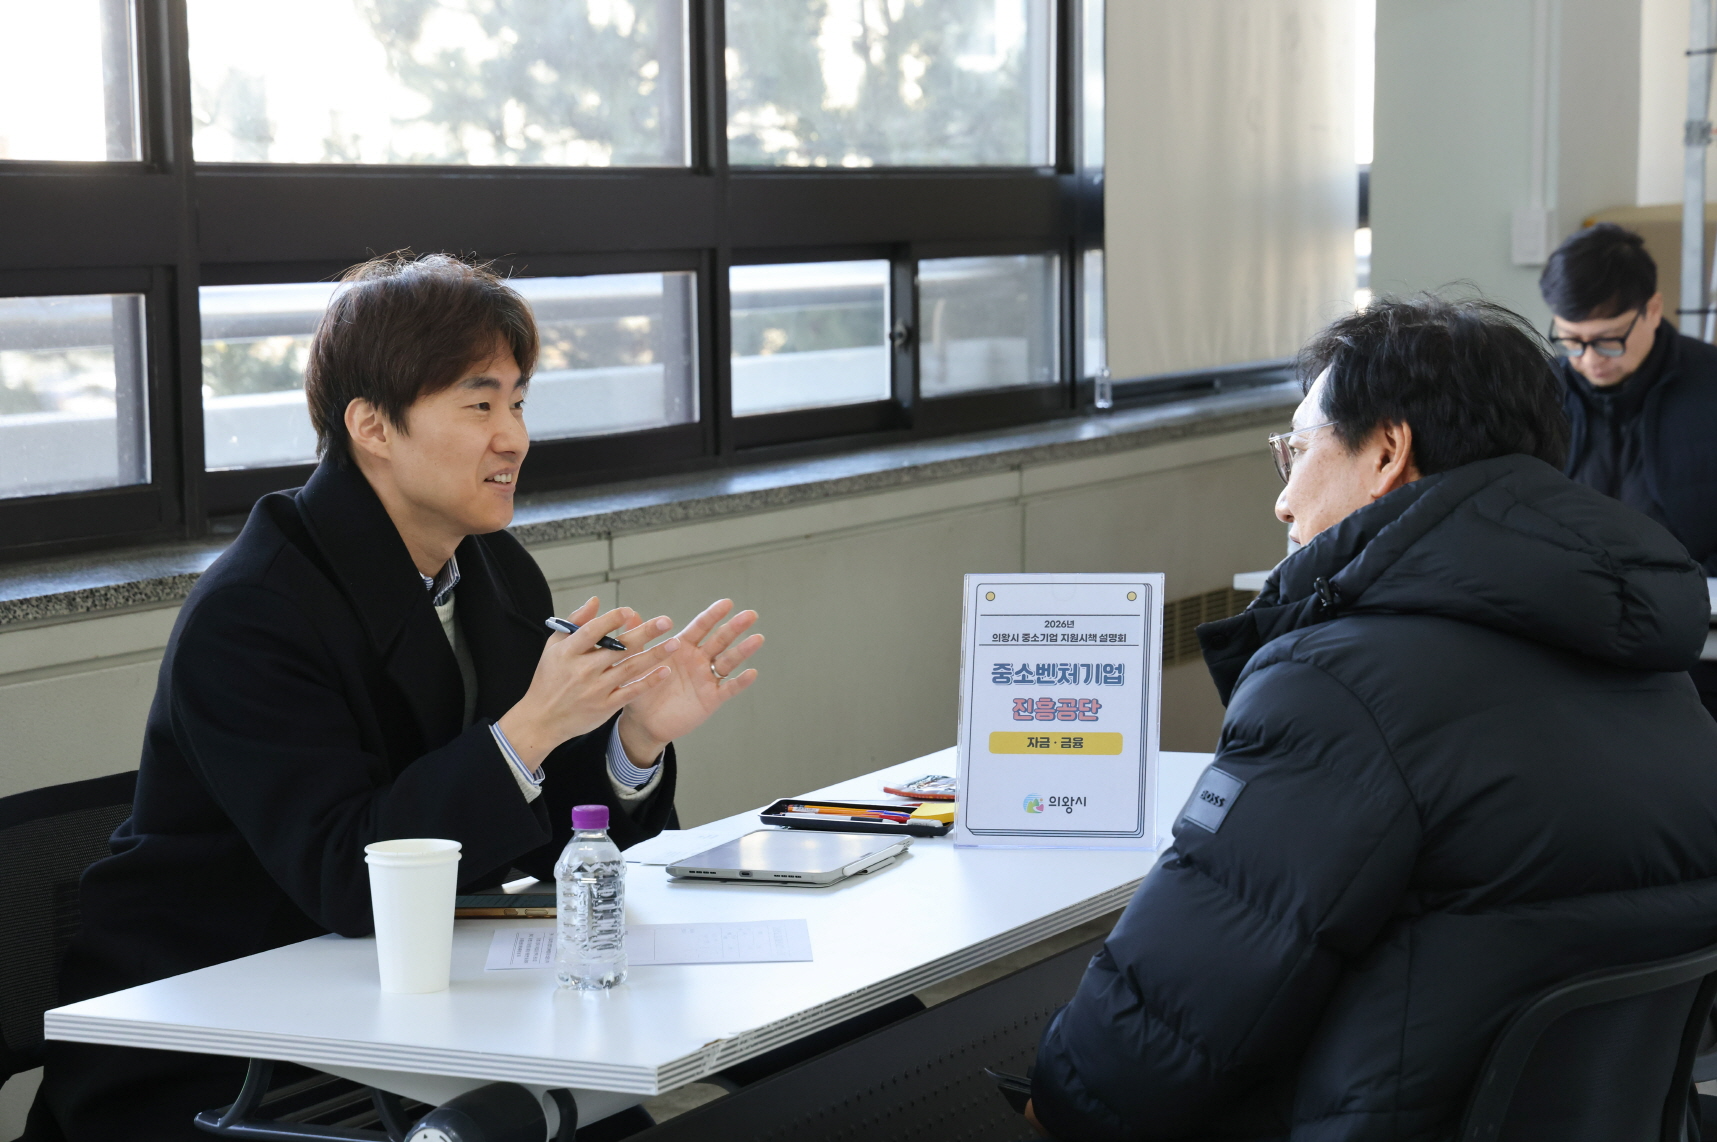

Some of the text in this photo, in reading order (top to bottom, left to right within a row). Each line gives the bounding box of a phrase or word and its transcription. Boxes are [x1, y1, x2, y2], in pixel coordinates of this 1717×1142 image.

[1044, 619, 1075, 629] 2026년
[992, 633, 1127, 643] 의왕시 중소기업 지원시책 설명회
[991, 662, 1125, 686] 중소벤처기업
[1012, 697, 1102, 722] 진흥공단
[1026, 737, 1084, 749] 자금 금융
[1048, 796, 1087, 814] 의왕시
[1200, 790, 1226, 808] BOSS
